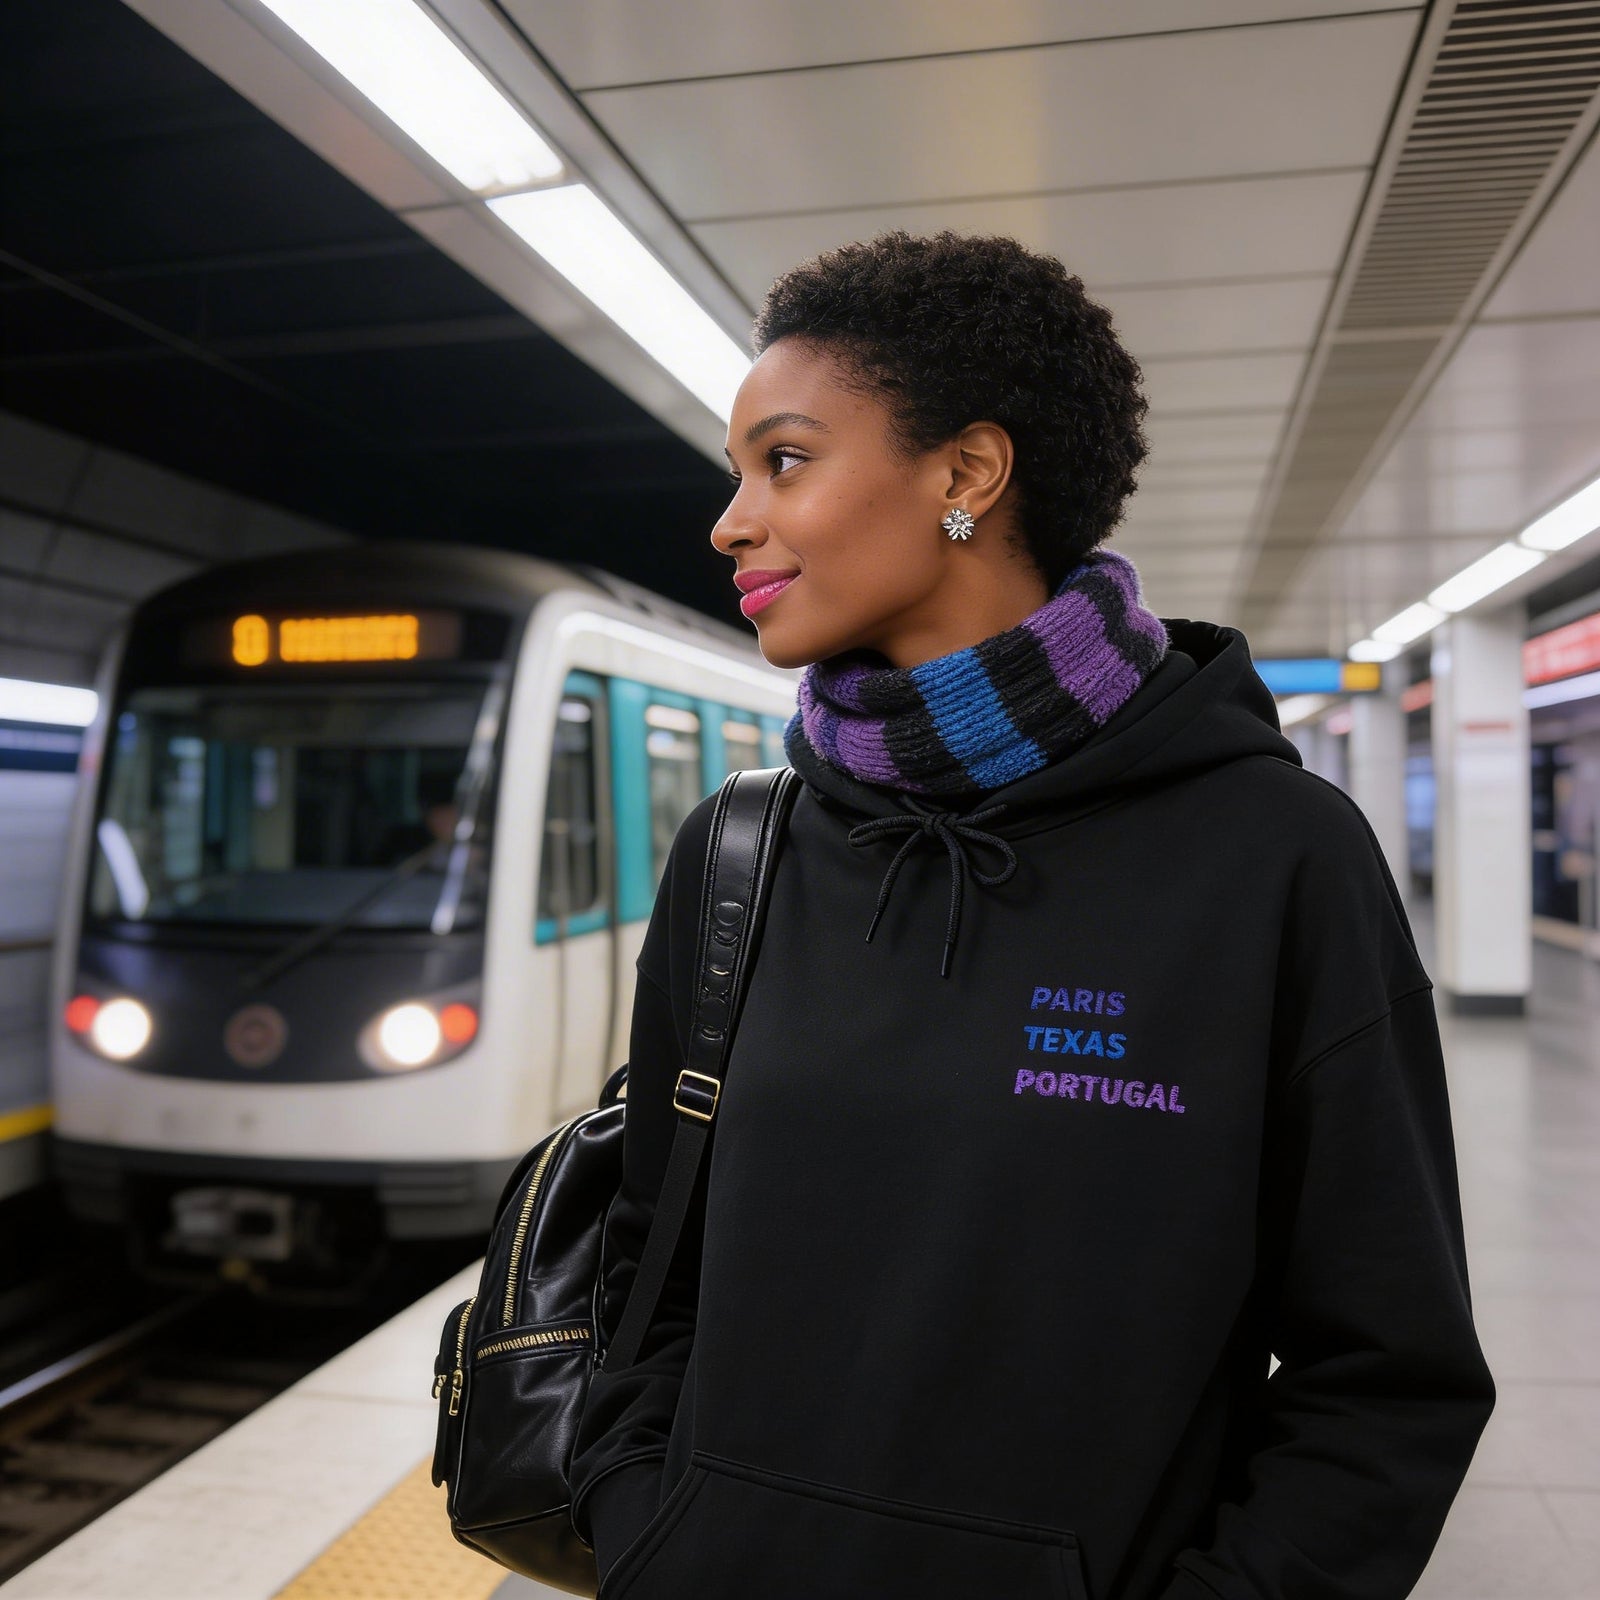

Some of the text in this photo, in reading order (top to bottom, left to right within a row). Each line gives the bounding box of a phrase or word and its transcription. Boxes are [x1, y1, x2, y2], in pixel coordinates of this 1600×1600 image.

[1030, 986, 1127, 1017] PARIS
[1023, 1025, 1128, 1060] TEXAS
[1013, 1068, 1186, 1114] PORTUGAL
